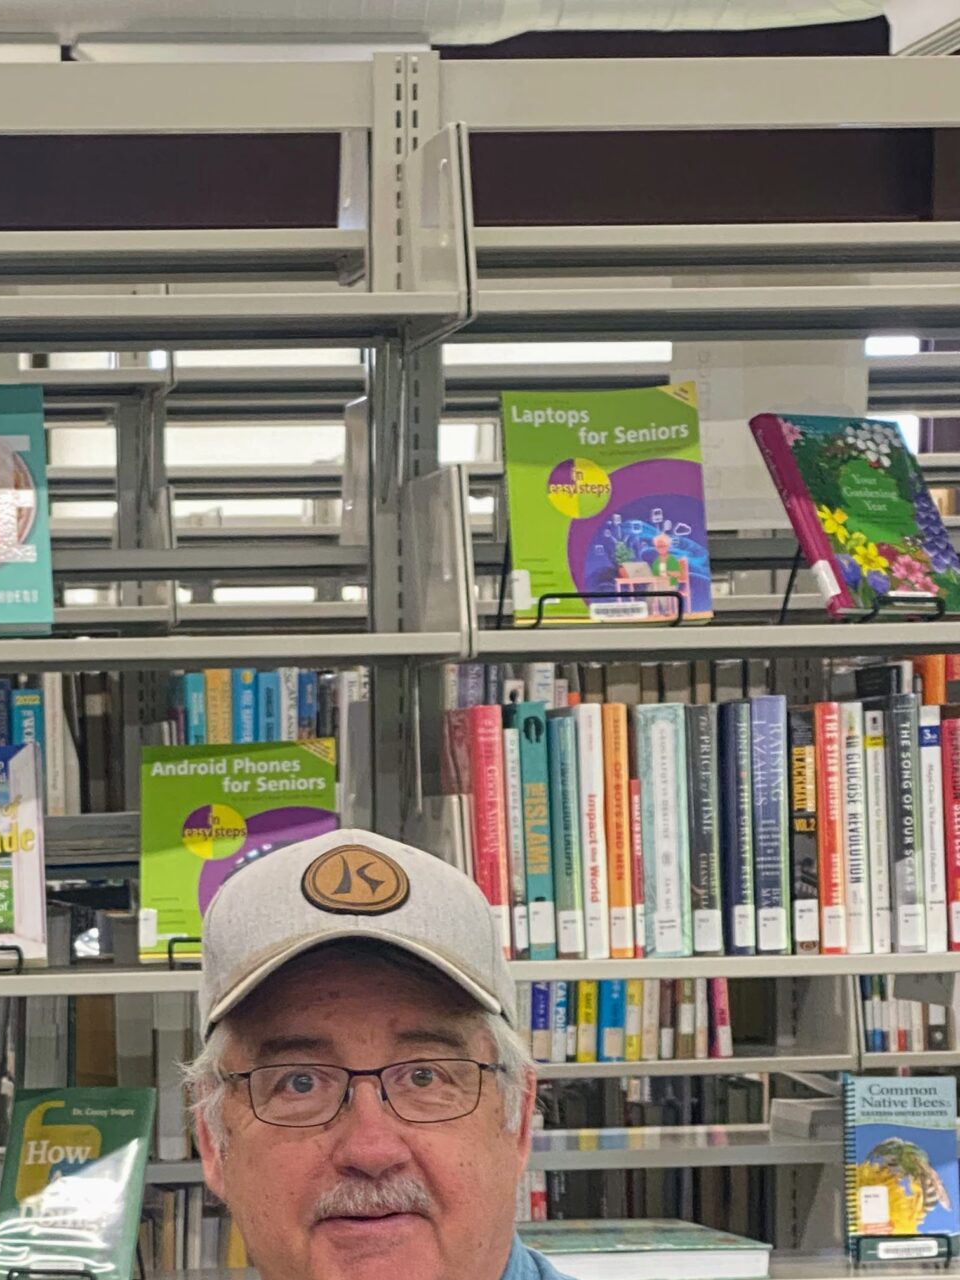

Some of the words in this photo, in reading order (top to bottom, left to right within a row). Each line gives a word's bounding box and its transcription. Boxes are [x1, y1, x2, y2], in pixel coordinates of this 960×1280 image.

[511, 405, 590, 428] Laptops
[579, 428, 609, 445] for
[614, 423, 689, 444] Seniors
[573, 468, 584, 481] in
[549, 484, 577, 499] easy
[577, 483, 611, 499] steps
[824, 715, 839, 740] THE
[900, 721, 913, 750] THE
[151, 758, 227, 776] Android
[233, 757, 302, 775] Phones
[700, 735, 713, 781] PRICE
[752, 720, 769, 807] LAZARUS
[770, 721, 785, 802] RAISING
[826, 745, 840, 773] STAR
[902, 752, 914, 790] SONG
[223, 777, 251, 792] for
[256, 775, 327, 792] Seniors
[793, 746, 807, 811] BLACKMAIL
[845, 753, 861, 806] GLUCOSE
[0, 794, 24, 819] of
[739, 784, 750, 810] THE
[904, 794, 915, 811] OF
[208, 813, 221, 825] in
[586, 793, 599, 846] Impact
[701, 796, 714, 835] TIME
[184, 828, 213, 843] easy
[214, 826, 247, 841] steps
[615, 822, 624, 850] AND
[740, 815, 751, 859] GREAT
[905, 817, 916, 845] OUR
[848, 813, 865, 885] REVOLUTION
[616, 853, 625, 881] MEN
[906, 849, 918, 893] SCARS
[590, 865, 601, 904] World
[861, 1097, 908, 1109] Native
[913, 1096, 946, 1108] Bees
[868, 1083, 938, 1097] Common
[72, 1108, 84, 1116] Dr.
[25, 1139, 93, 1166] How
